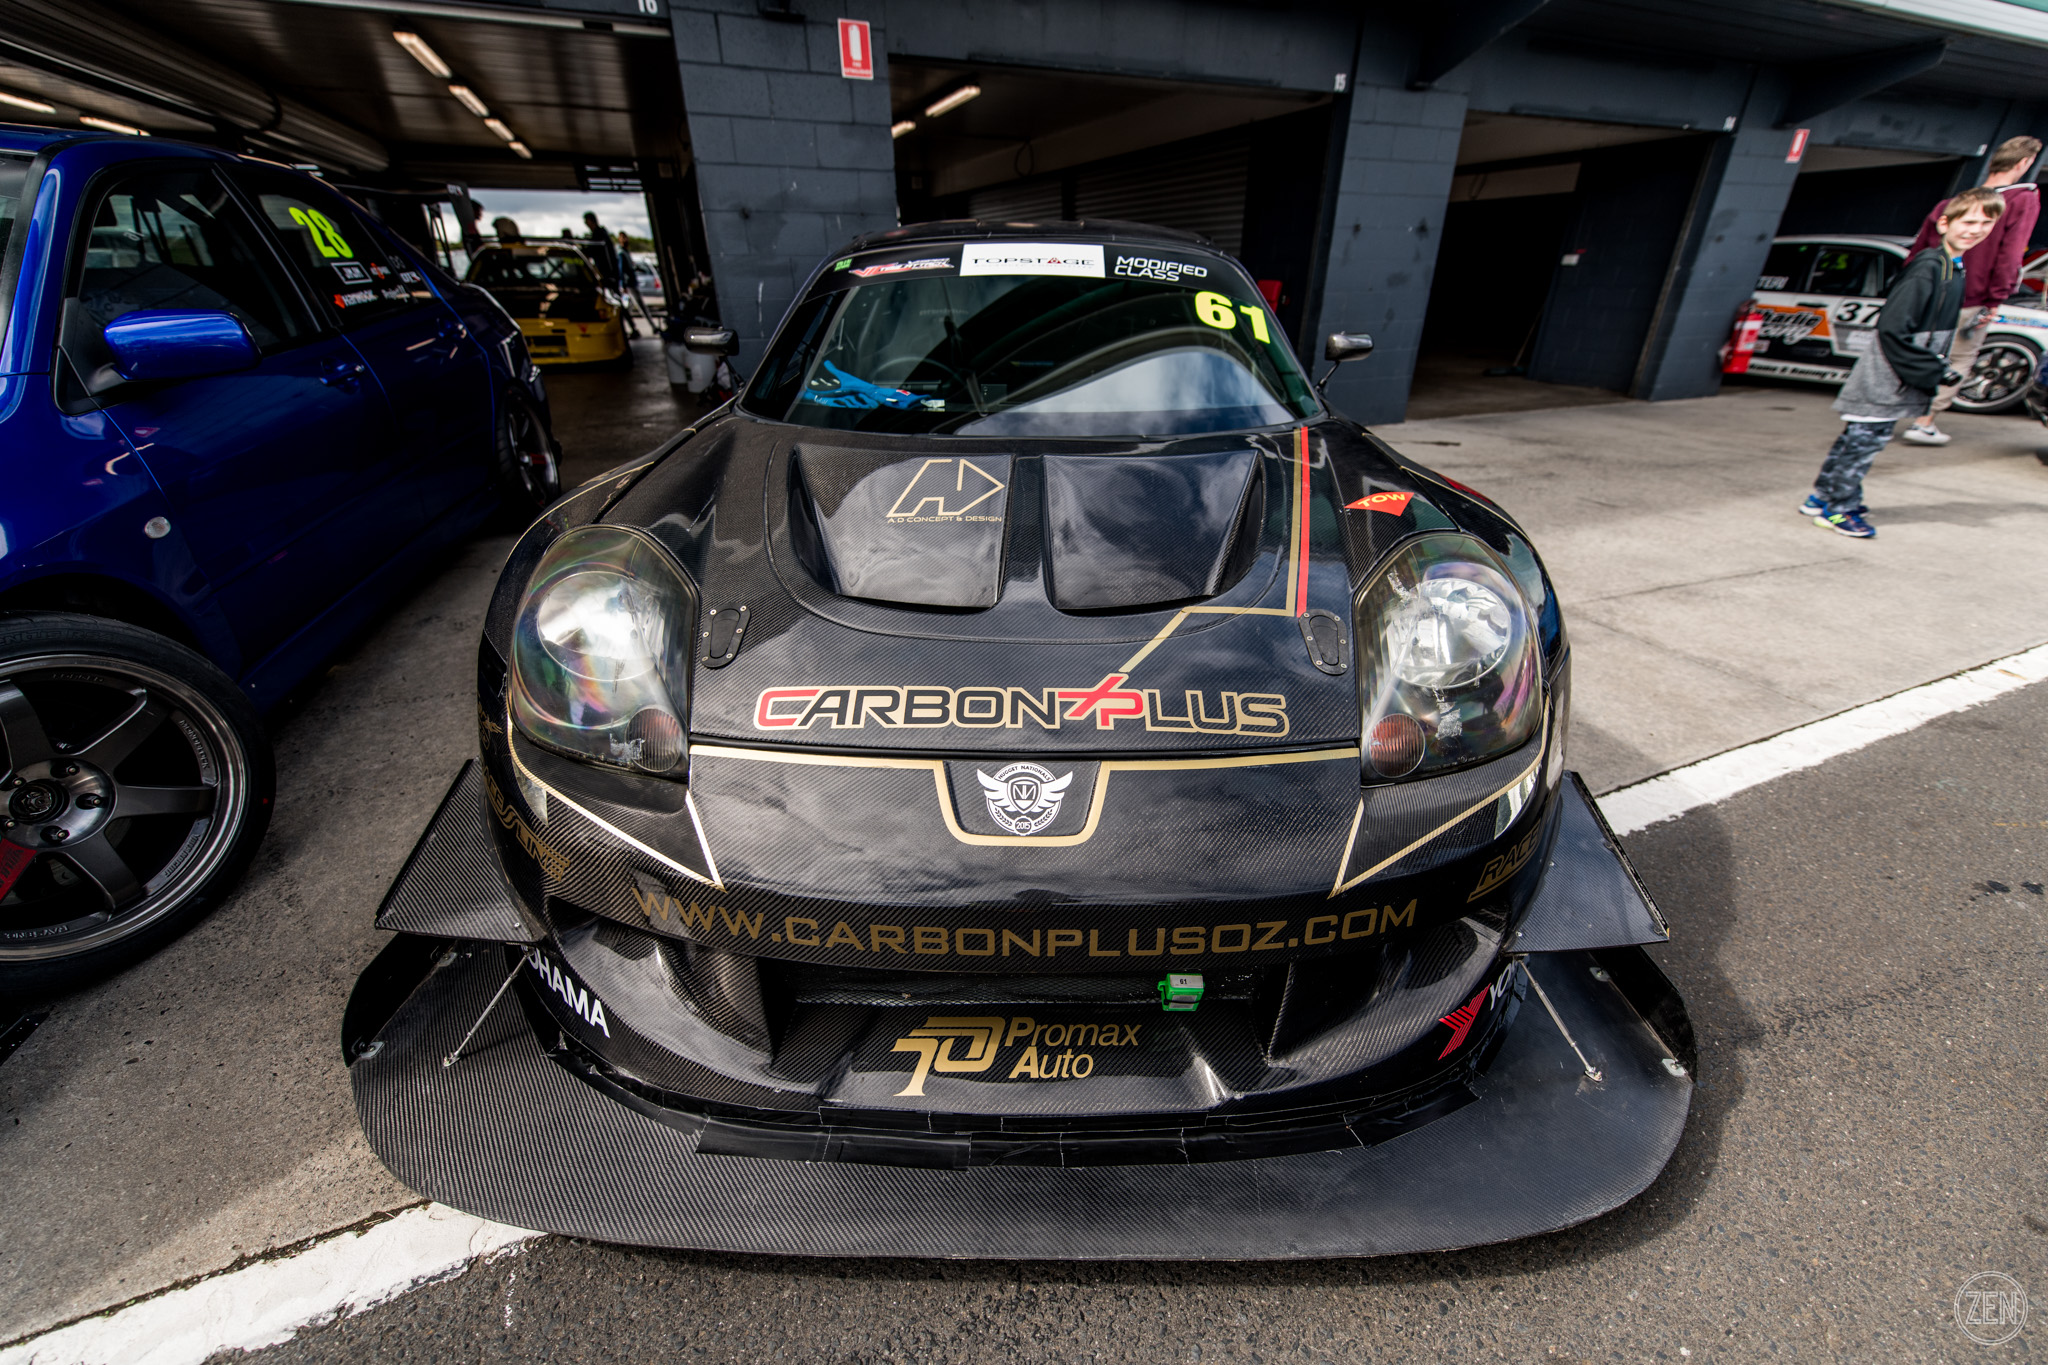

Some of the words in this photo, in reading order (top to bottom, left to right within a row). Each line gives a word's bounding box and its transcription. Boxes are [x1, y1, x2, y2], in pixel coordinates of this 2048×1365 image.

[288, 206, 354, 259] 28
[1114, 265, 1180, 282] CLASS
[1116, 255, 1208, 278] MODIFIED
[1195, 290, 1271, 345] 61
[1756, 308, 1823, 328] harlie
[1836, 303, 1883, 324] 37
[1357, 493, 1406, 508] TOW
[998, 765, 1019, 780] NUGGET
[1020, 765, 1051, 781] NATIONALS
[1015, 821, 1031, 830] 2015
[631, 887, 1417, 957] WWW.CARBONPLUSOZ.COM
[1004, 1016, 1142, 1047] Promax
[1008, 1046, 1094, 1079] Auto
